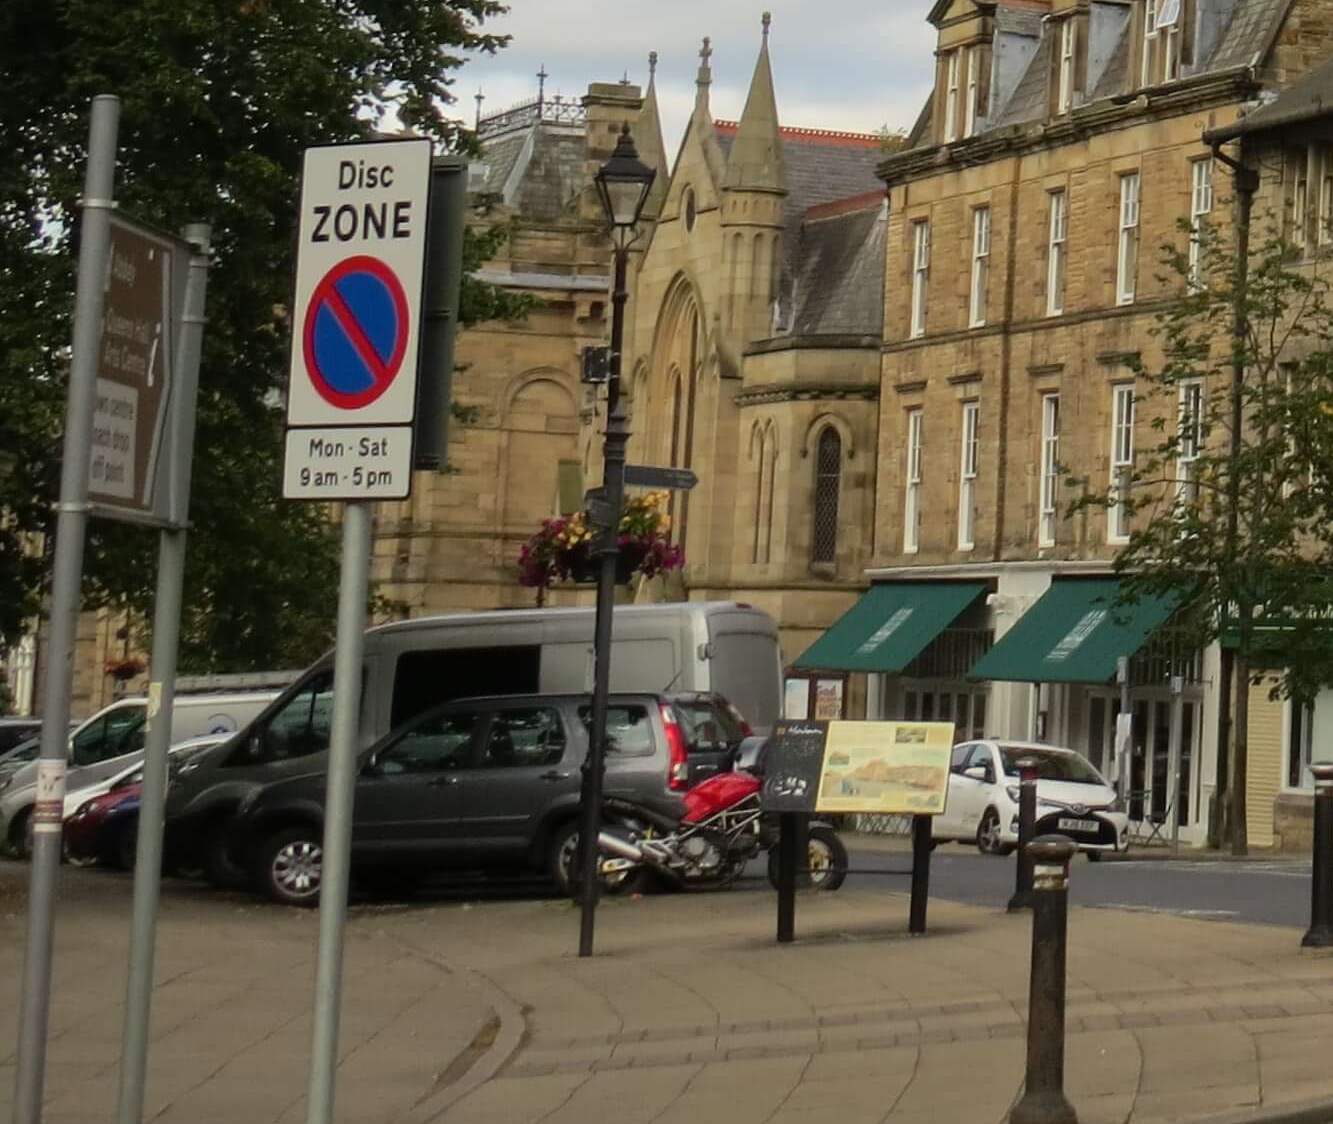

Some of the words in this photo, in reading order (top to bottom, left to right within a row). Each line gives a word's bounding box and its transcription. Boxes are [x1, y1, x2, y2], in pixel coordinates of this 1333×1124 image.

[338, 159, 394, 190] Disc
[311, 200, 413, 243] ZONE
[309, 437, 344, 458] Mon
[358, 436, 389, 457] Sat
